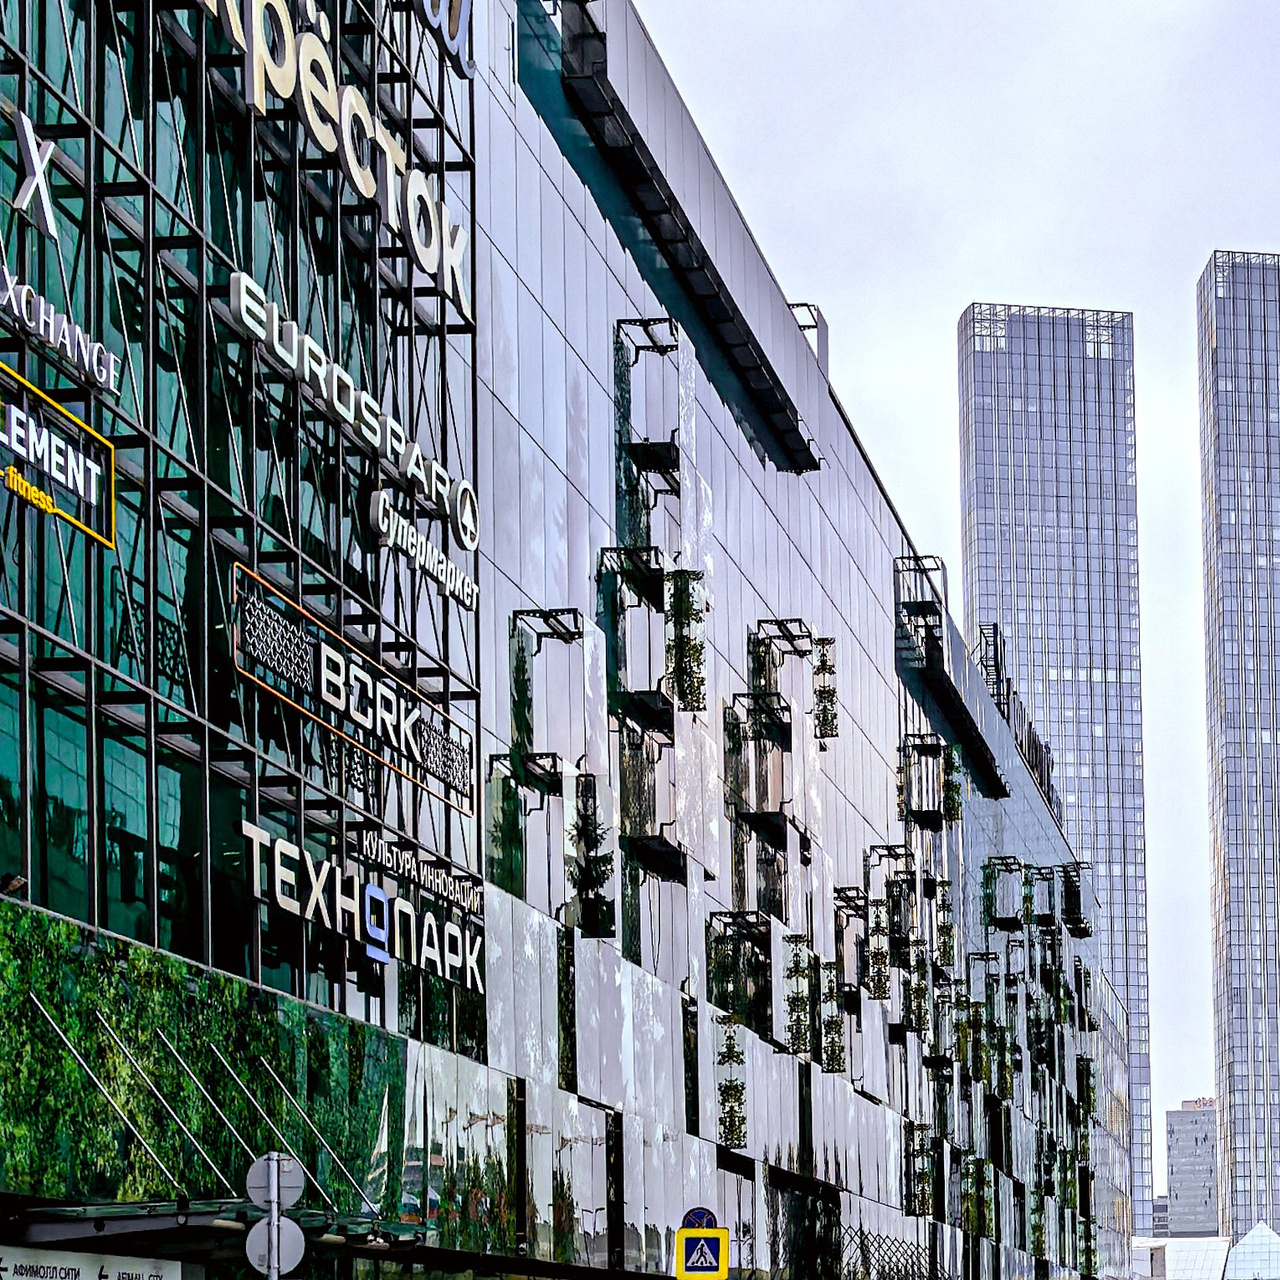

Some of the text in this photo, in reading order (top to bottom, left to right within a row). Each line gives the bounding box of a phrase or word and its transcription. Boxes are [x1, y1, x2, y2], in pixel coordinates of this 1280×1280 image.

[217, 0, 475, 326] рёсток
[233, 271, 450, 515] EUROSPAR
[5, 465, 54, 514] fitness
[374, 490, 479, 612] Супермаркет
[242, 819, 484, 995] ТЕХНОПАРК
[363, 829, 480, 913] КУЛЬТУРА ИННОВАЦИЙ
[12, 1263, 81, 1280] АФИМОЛЛ СИТИ
